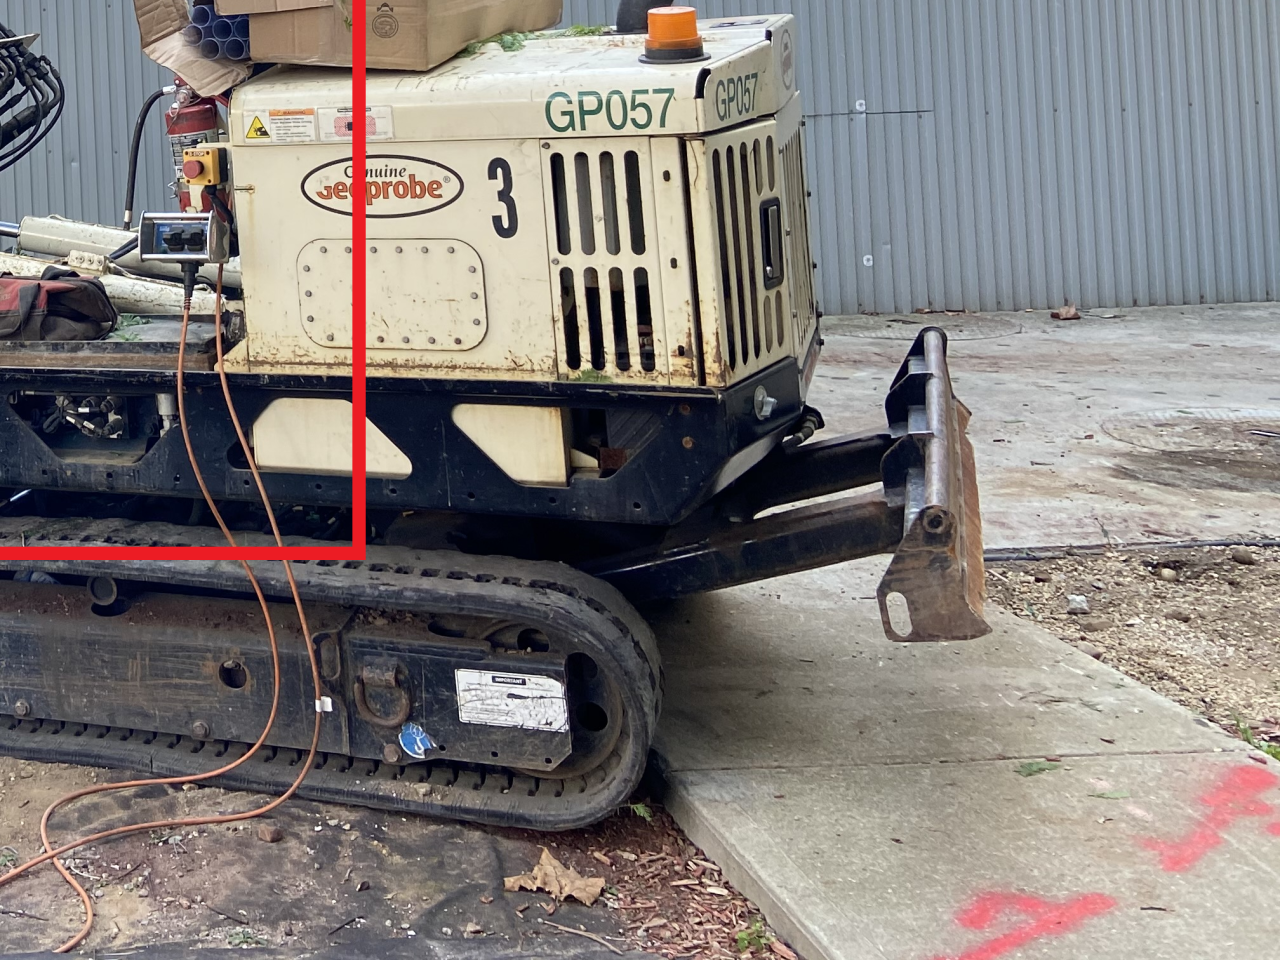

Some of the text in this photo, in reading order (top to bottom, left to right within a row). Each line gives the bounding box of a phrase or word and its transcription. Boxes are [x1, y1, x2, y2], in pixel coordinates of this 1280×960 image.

[544, 87, 675, 133] GP057
[715, 72, 759, 122] GP057
[344, 165, 407, 179] Gnuine
[487, 157, 518, 239] 3
